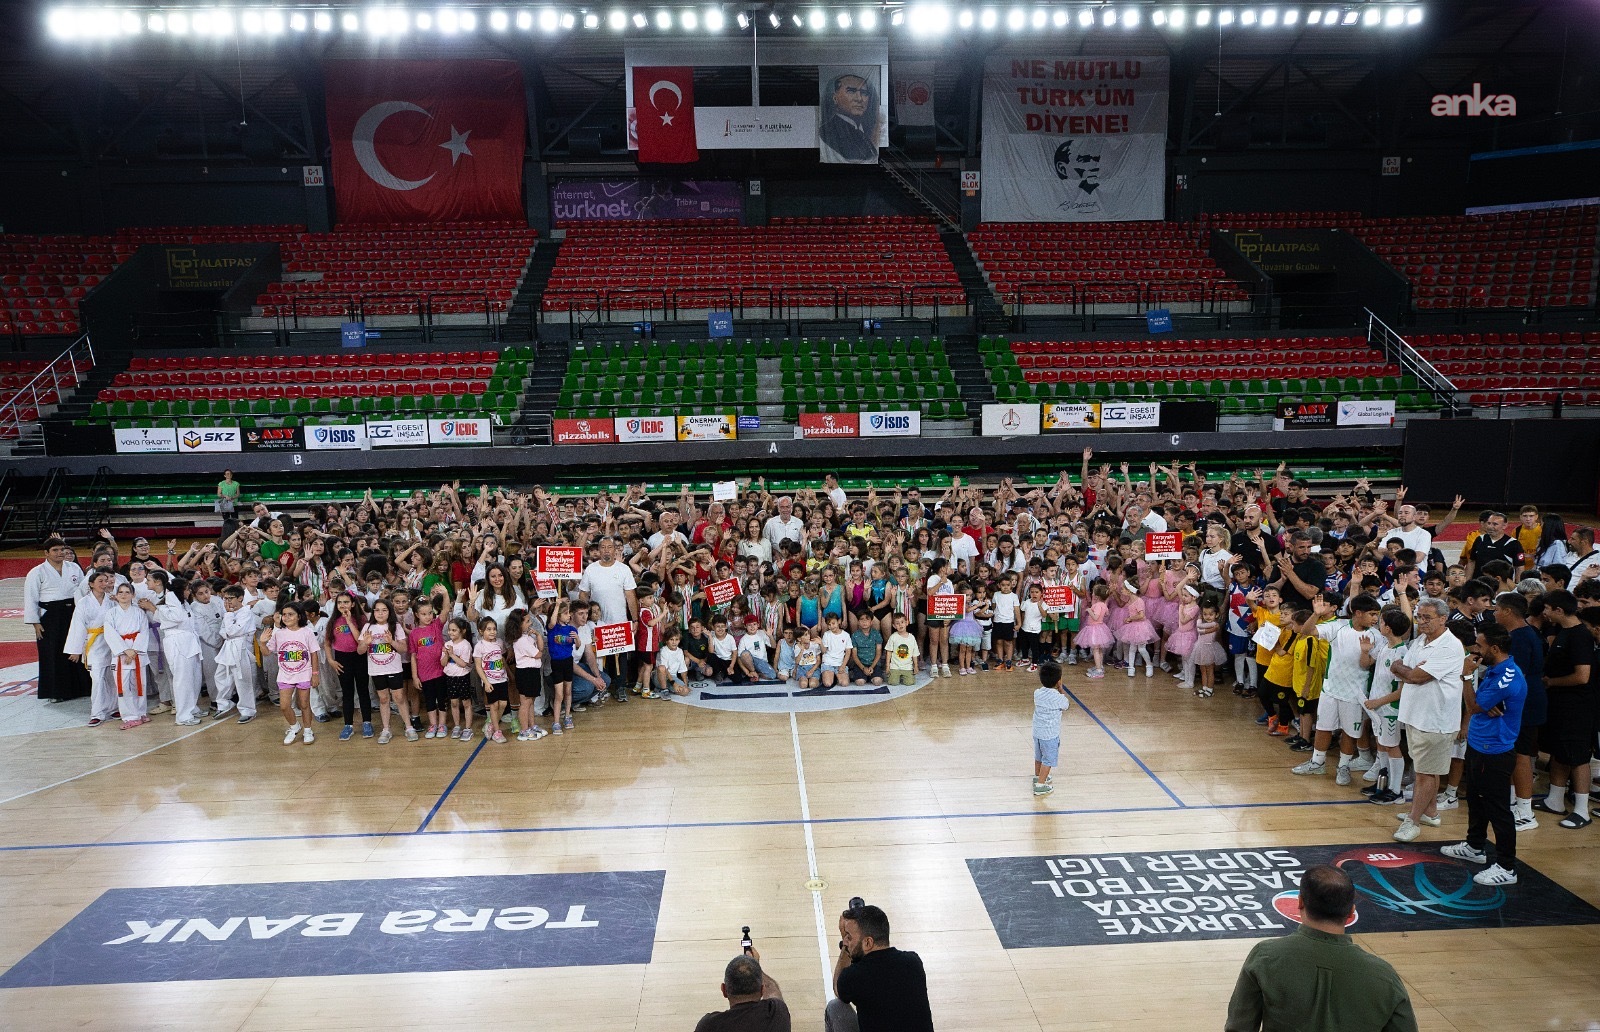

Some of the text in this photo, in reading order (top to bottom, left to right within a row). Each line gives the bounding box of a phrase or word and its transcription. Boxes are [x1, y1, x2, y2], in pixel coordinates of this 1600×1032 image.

[1011, 60, 1141, 80] NE MUTLU
[1017, 83, 1134, 106] TÜRK'ÜM
[1026, 110, 1129, 134] DİYENE!
[308, 168, 318, 176] C-1
[305, 176, 322, 184] BLOK
[554, 200, 632, 218] turknet
[1297, 404, 1328, 415] ASY
[262, 428, 294, 440] ASY
[558, 431, 610, 441] pizzabulls
[804, 426, 854, 435] pizzabulls
[204, 433, 235, 442] SKZ
[1172, 435, 1179, 445] C
[769, 442, 778, 453] A
[294, 454, 302, 465] B
[546, 556, 574, 564] Belediyesi
[1353, 722, 1362, 731] 17
[1367, 852, 1403, 861] TBF
[1045, 850, 1302, 878] SÜPER LİGİ
[1031, 870, 1305, 898] BASKETBOL
[1082, 894, 1263, 916] SİGORTA
[102, 912, 364, 946] BANK
[1098, 912, 1286, 936] TÜRKİYE
